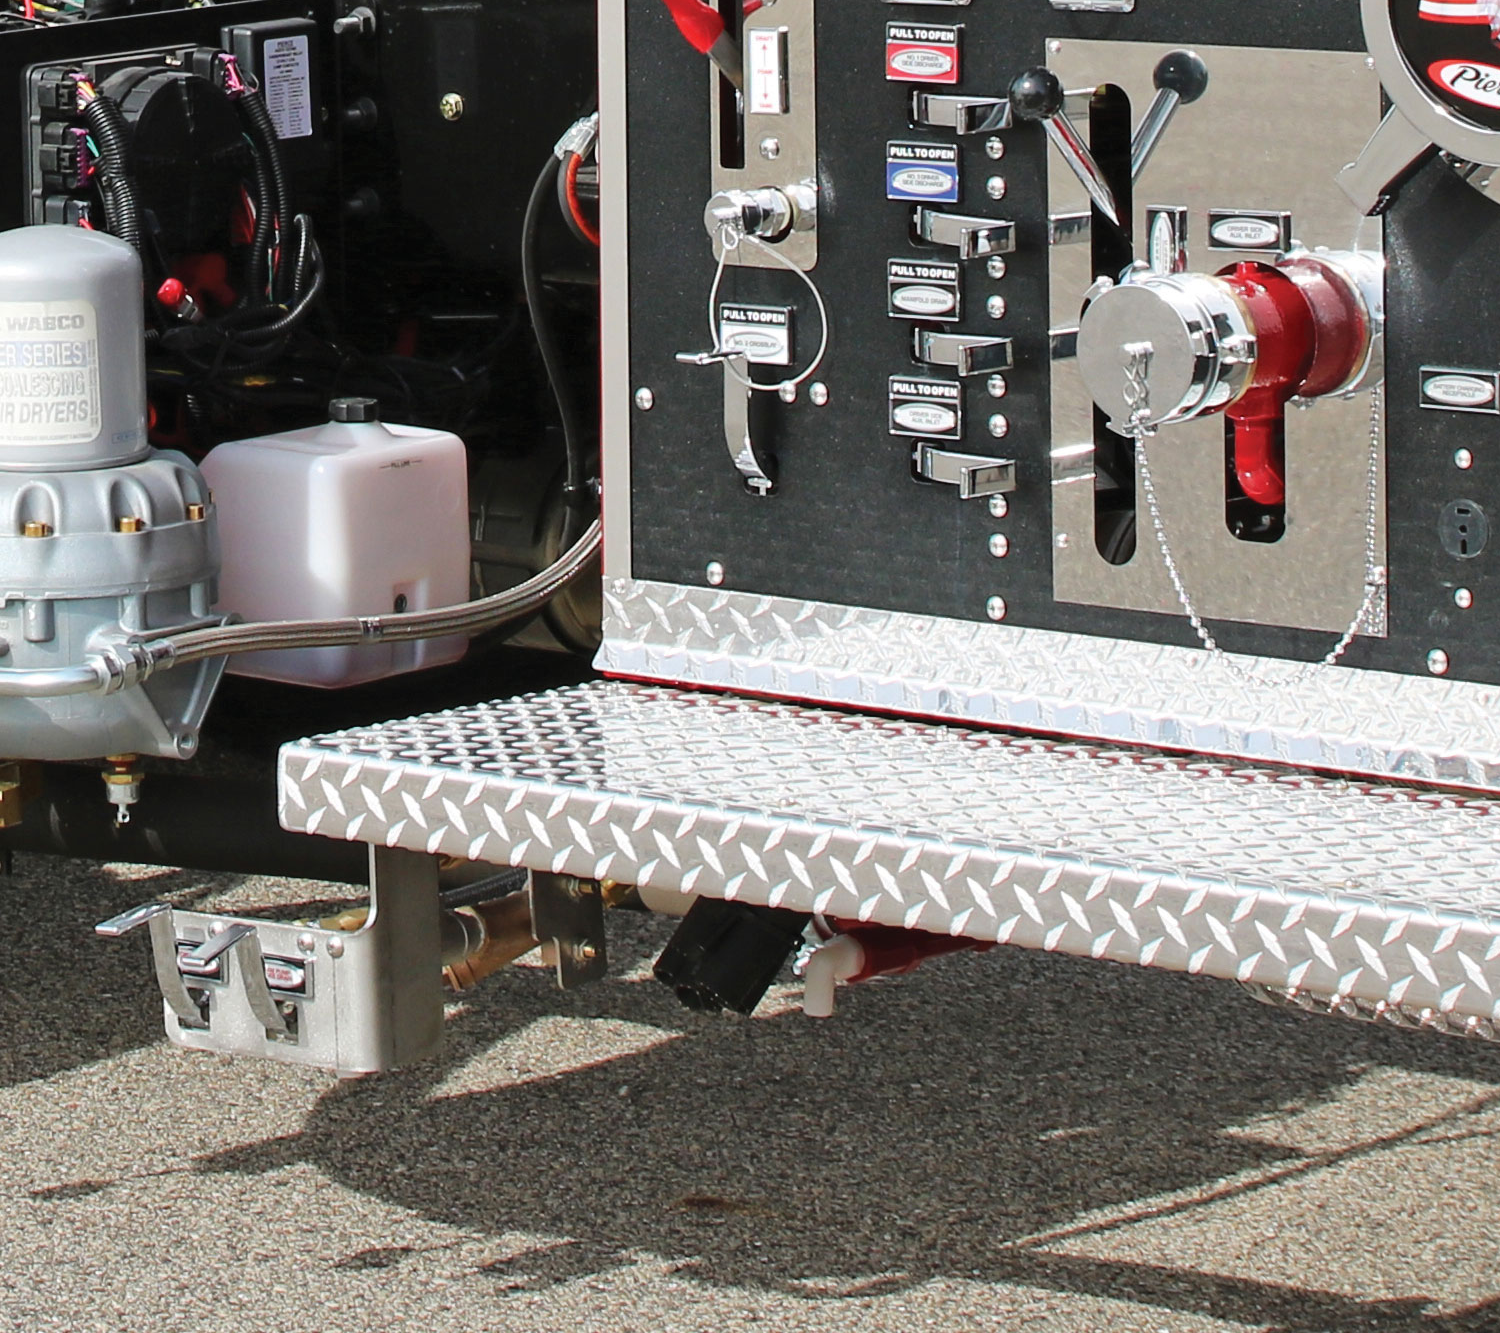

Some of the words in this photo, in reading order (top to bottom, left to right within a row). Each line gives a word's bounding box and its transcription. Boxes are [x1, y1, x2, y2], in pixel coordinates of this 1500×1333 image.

[889, 28, 913, 39] PULL
[914, 29, 927, 40] TO
[927, 30, 954, 41] OPEN
[890, 147, 914, 158] PULL
[914, 147, 928, 158] TO
[928, 149, 954, 160] OPEN
[891, 265, 915, 277] PULL
[915, 266, 928, 277] TO
[929, 267, 956, 279] OPEN
[901, 296, 929, 304] MANIFOLD
[6, 314, 85, 332] WABCO
[723, 309, 746, 320] PULL
[746, 312, 760, 321] TO
[760, 313, 785, 323] OPEN
[21, 342, 84, 367] SERIES
[893, 382, 917, 394] PULL
[917, 384, 930, 395] TO
[931, 385, 958, 397] OPEN
[1442, 390, 1475, 398] RECEPTACLE
[1456, 385, 1485, 393] CHARGING
[19, 400, 90, 424] DRYERS
